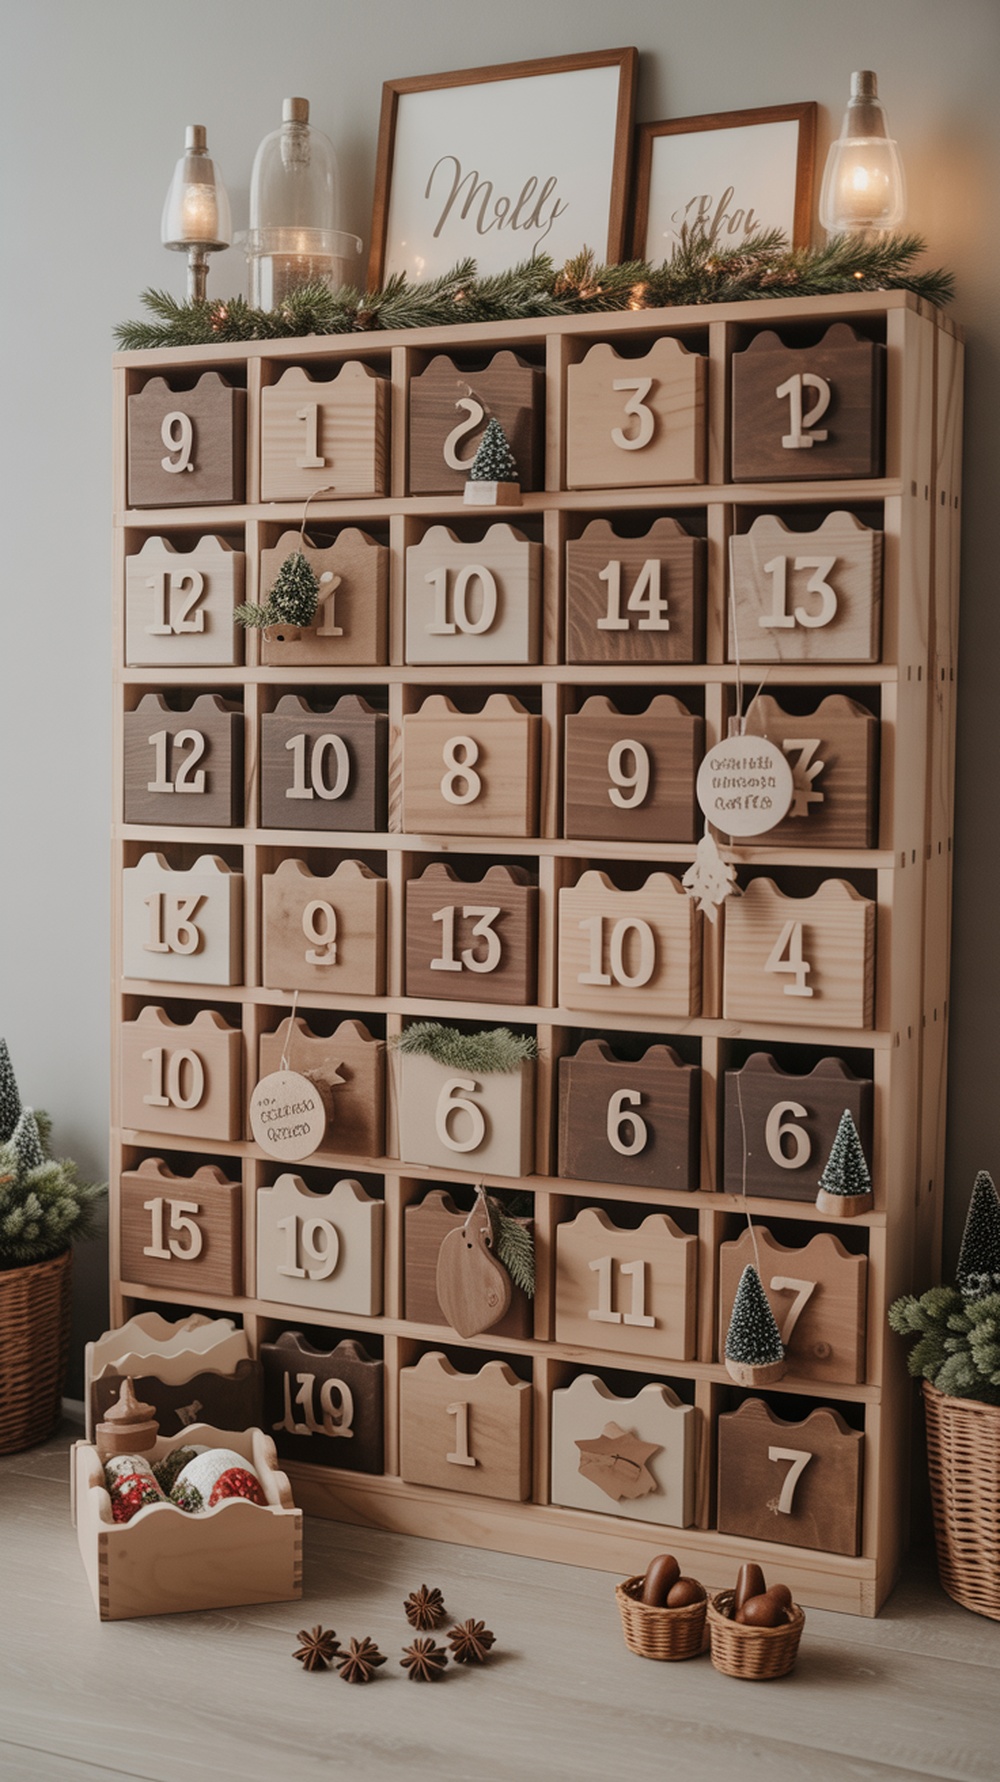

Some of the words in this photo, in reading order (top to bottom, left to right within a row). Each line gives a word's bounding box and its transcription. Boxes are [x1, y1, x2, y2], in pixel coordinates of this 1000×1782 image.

[296, 403, 326, 469] 1
[611, 375, 656, 452] 3
[145, 568, 206, 636] 12
[424, 564, 498, 636] 10
[597, 559, 670, 632] 14
[758, 555, 838, 630] 13
[147, 728, 206, 795] 12
[284, 733, 350, 801] 10
[440, 735, 482, 806] 8
[607, 738, 651, 810] 9
[430, 904, 501, 974] 13
[577, 916, 656, 989] 10
[764, 920, 814, 998] 4
[141, 1046, 205, 1111] 10
[436, 1077, 486, 1153] 6
[606, 1088, 648, 1157] 6
[764, 1100, 812, 1170] 6
[142, 1196, 204, 1261] 15
[276, 1214, 340, 1281] 19
[587, 1255, 656, 1329] 11
[769, 1275, 819, 1347] 7
[445, 1401, 477, 1468] 1
[768, 1446, 813, 1515] 7
